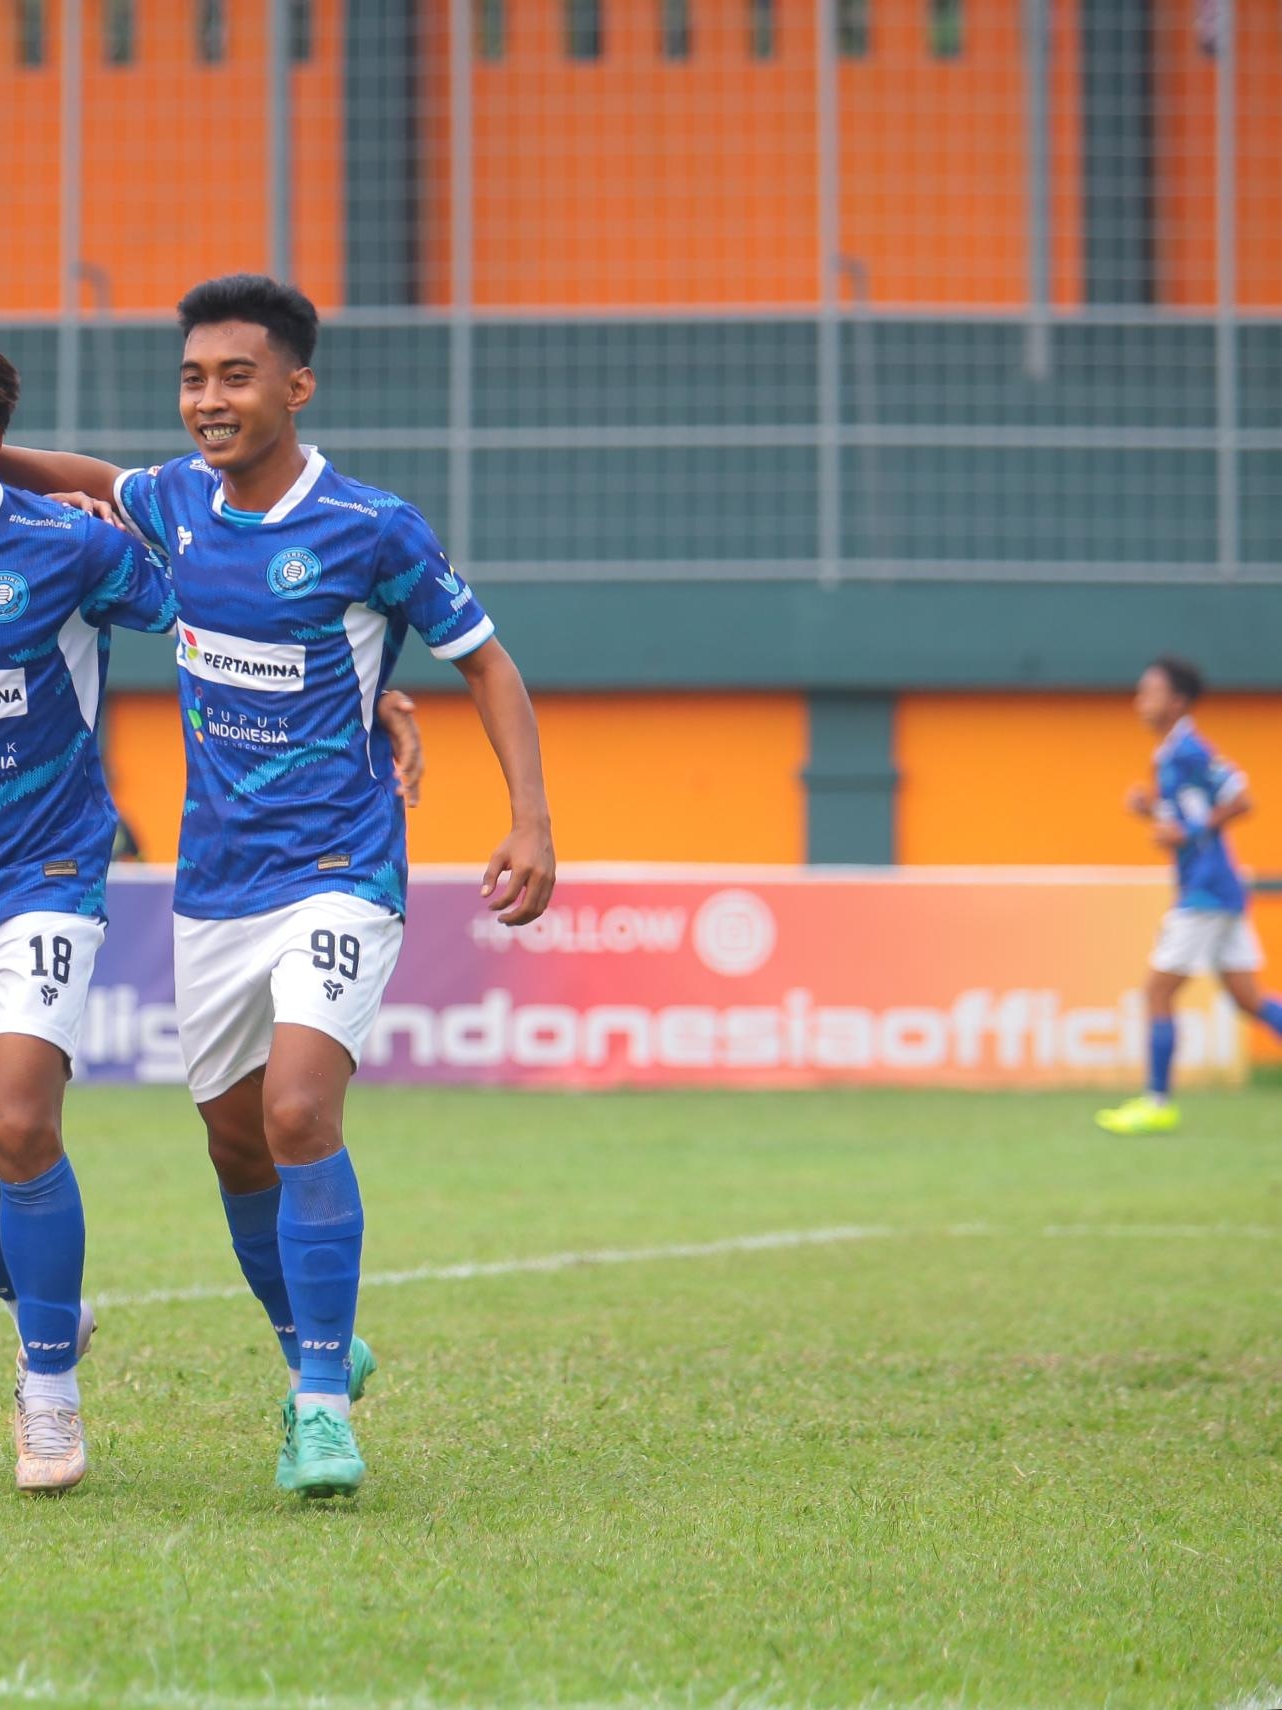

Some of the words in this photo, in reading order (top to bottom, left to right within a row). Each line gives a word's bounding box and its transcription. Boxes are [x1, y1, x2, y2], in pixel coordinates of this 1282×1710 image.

[318, 496, 378, 518] #MacanMuria
[9, 514, 72, 529] #MacanMuria
[204, 652, 301, 678] PERTAMINA
[206, 706, 289, 729] PUPUK
[208, 721, 288, 743] INDONESIA
[29, 935, 72, 984] 18
[311, 929, 360, 981] 99
